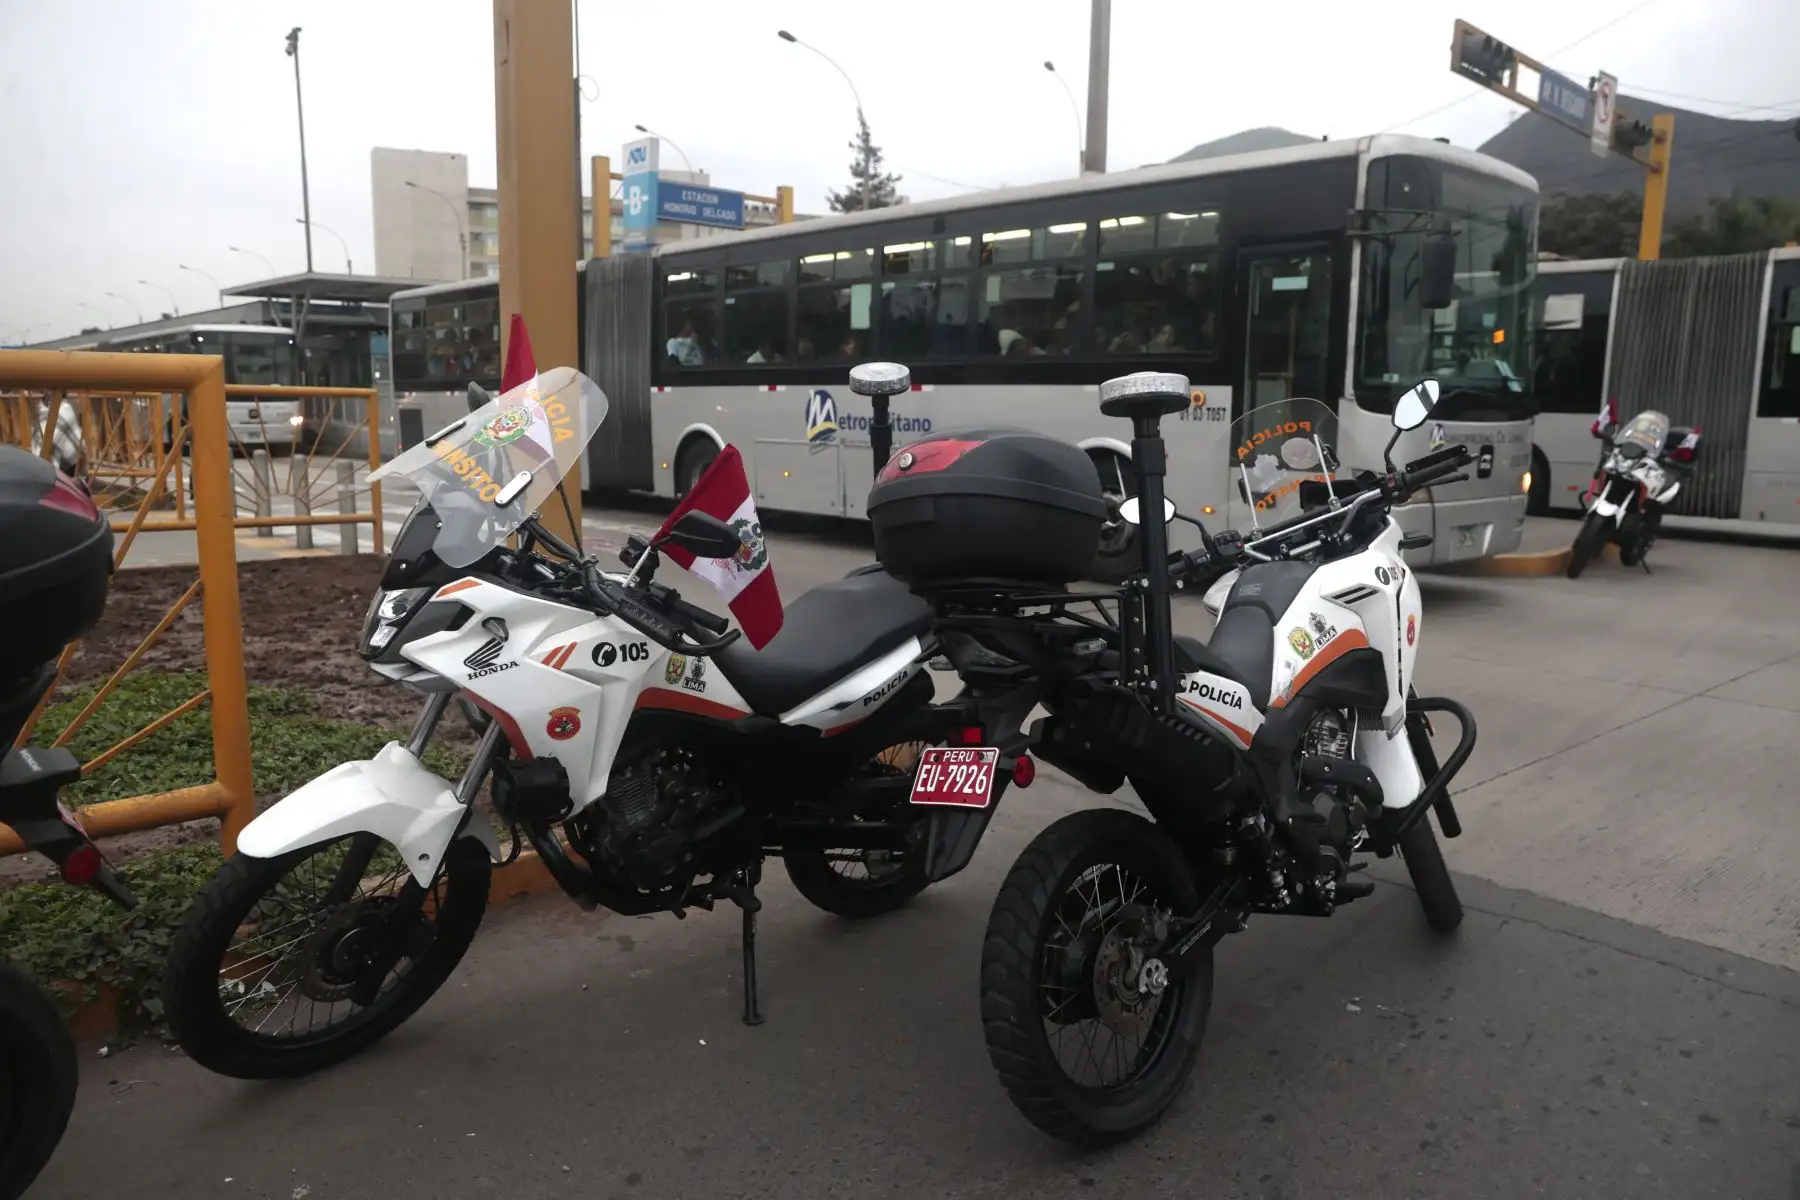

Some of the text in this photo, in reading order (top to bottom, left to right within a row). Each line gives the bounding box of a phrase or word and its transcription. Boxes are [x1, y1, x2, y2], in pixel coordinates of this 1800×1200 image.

[520, 388, 574, 445] ICIA
[431, 439, 502, 502] NSITO
[1315, 626, 1338, 649] LIMA
[620, 642, 650, 662] 105
[467, 660, 519, 680] HONDA
[682, 679, 706, 692] LIMA
[1189, 680, 1242, 710] POLICÍA
[943, 751, 974, 762] PERU
[916, 764, 989, 794] EU-7926
